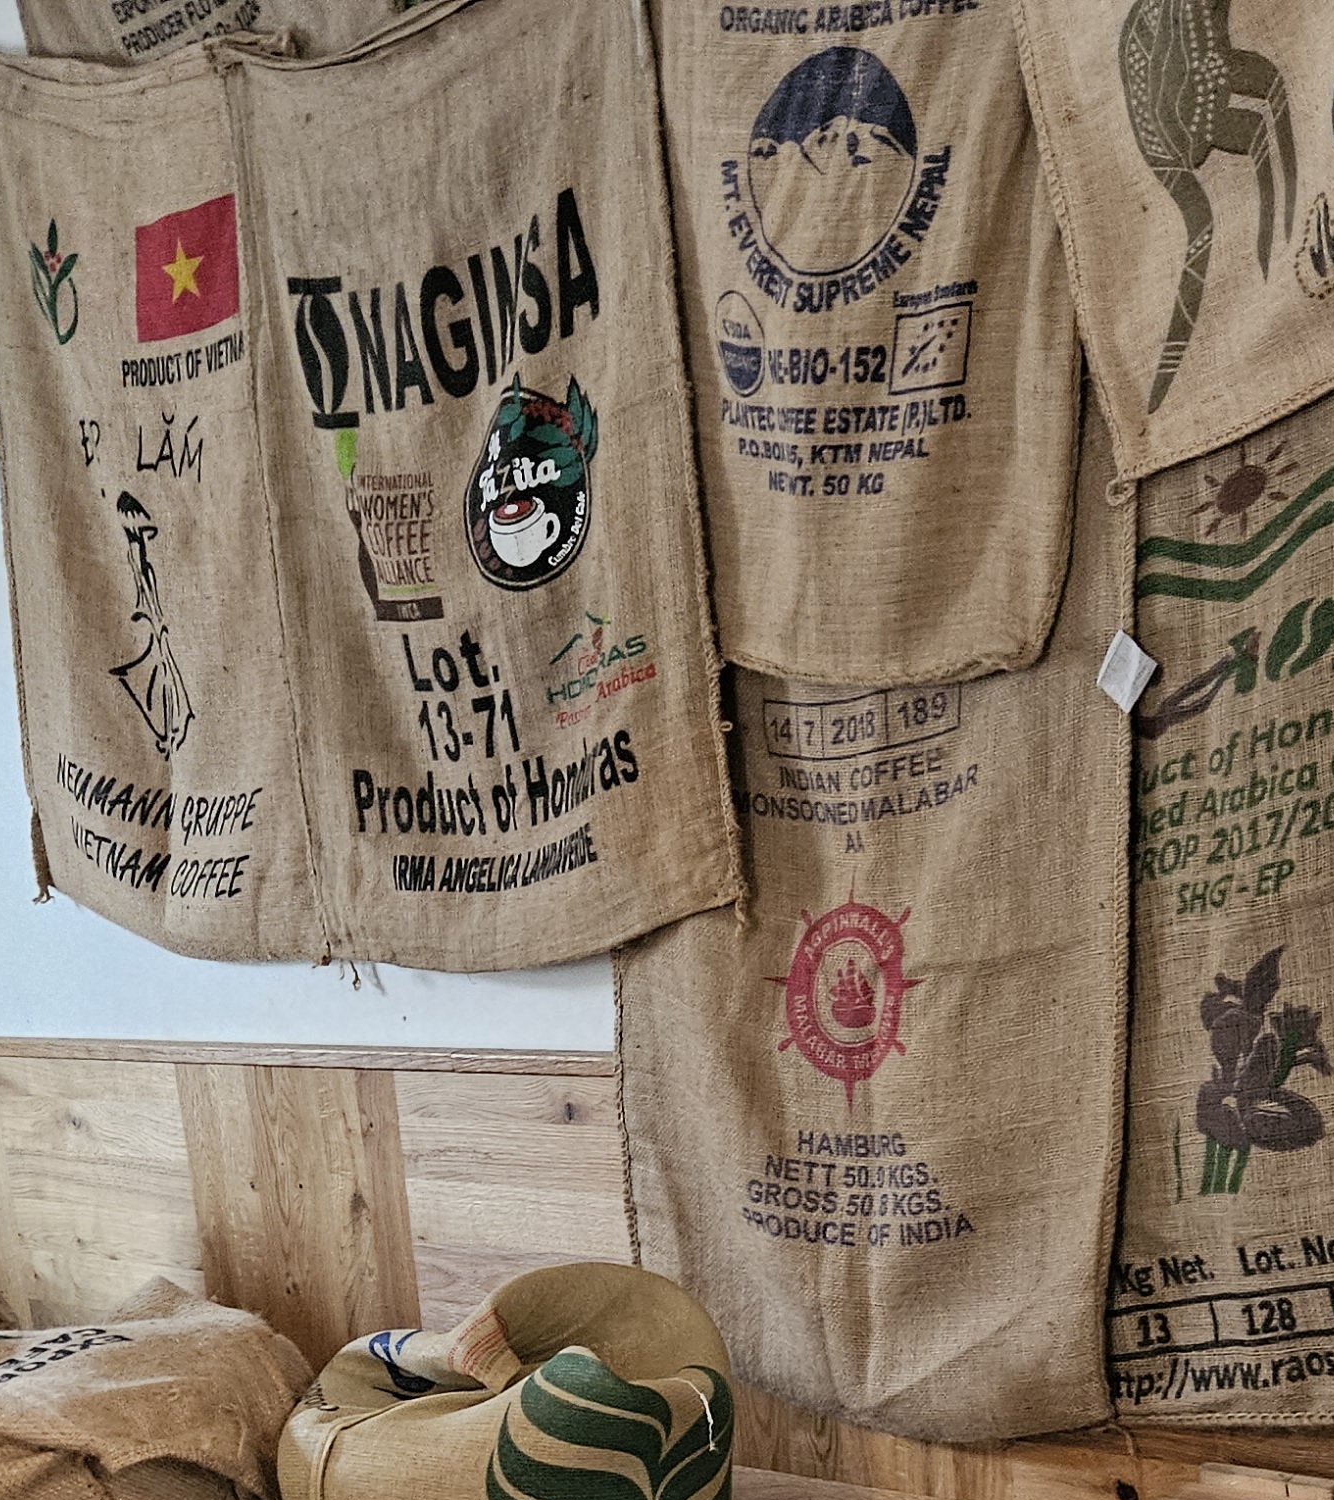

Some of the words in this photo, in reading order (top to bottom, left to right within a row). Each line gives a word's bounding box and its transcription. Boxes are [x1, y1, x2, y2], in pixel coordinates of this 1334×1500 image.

[720, 6, 808, 34] ORGANIC
[793, 234, 911, 313] SUPREME
[898, 145, 951, 242] NEPAL
[122, 353, 181, 387] PRODUCT
[186, 348, 201, 379] OF
[205, 330, 244, 372] VIETNA
[822, 405, 899, 435] ESTATE
[810, 444, 862, 465] KTM
[868, 437, 930, 464] NEPAL
[823, 475, 850, 496] 50
[857, 472, 884, 494] KG
[366, 520, 432, 556] COFFEE
[402, 629, 499, 692] Lot.
[419, 689, 520, 762] 13-71
[770, 717, 792, 743] 14
[804, 721, 815, 746] 7
[779, 766, 840, 793] INDIAN
[850, 748, 943, 789] COFFEE
[1208, 731, 1242, 777] of
[56, 752, 177, 831] NEUMANN
[181, 787, 263, 846] GRUPPE
[352, 768, 486, 835] Product
[492, 764, 518, 833] of
[1196, 761, 1318, 823] Arabica
[71, 815, 171, 892] VIETNAM
[171, 855, 250, 898] COFFEE
[393, 855, 435, 891] IRMA
[439, 853, 518, 892] ANGELICA
[1139, 834, 1199, 884] ROP
[765, 1154, 837, 1187] NETT
[747, 1179, 838, 1214] GROSS
[742, 1207, 856, 1246] PRODUCE
[868, 1223, 891, 1247] OF
[900, 1213, 976, 1246] INDIA
[1159, 1254, 1214, 1287] Net.
[1237, 1246, 1296, 1276] Lot.
[1137, 1313, 1171, 1347] 13
[1242, 1298, 1297, 1335] 128
